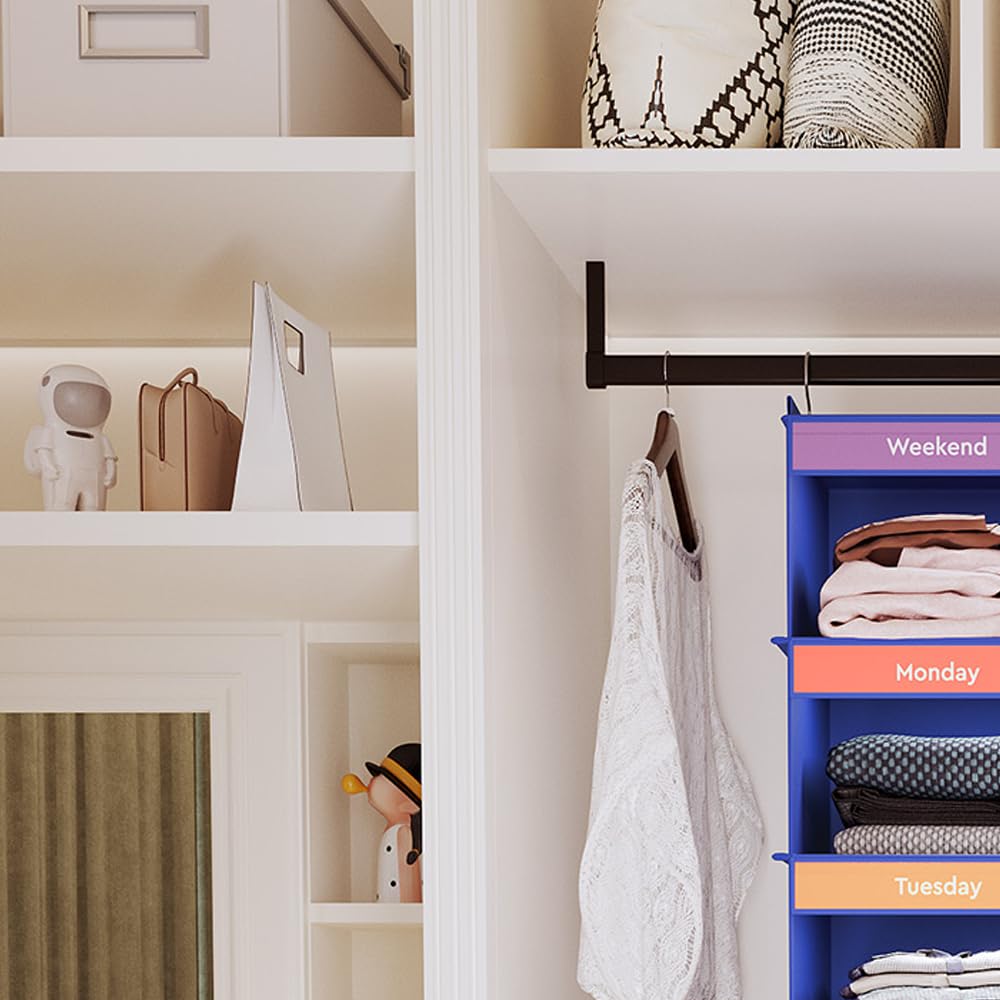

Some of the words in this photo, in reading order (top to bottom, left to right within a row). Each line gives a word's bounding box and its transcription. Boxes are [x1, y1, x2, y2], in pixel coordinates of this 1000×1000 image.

[886, 435, 988, 456] Weekend
[896, 661, 981, 686] Monday
[894, 875, 983, 900] Tuesday
